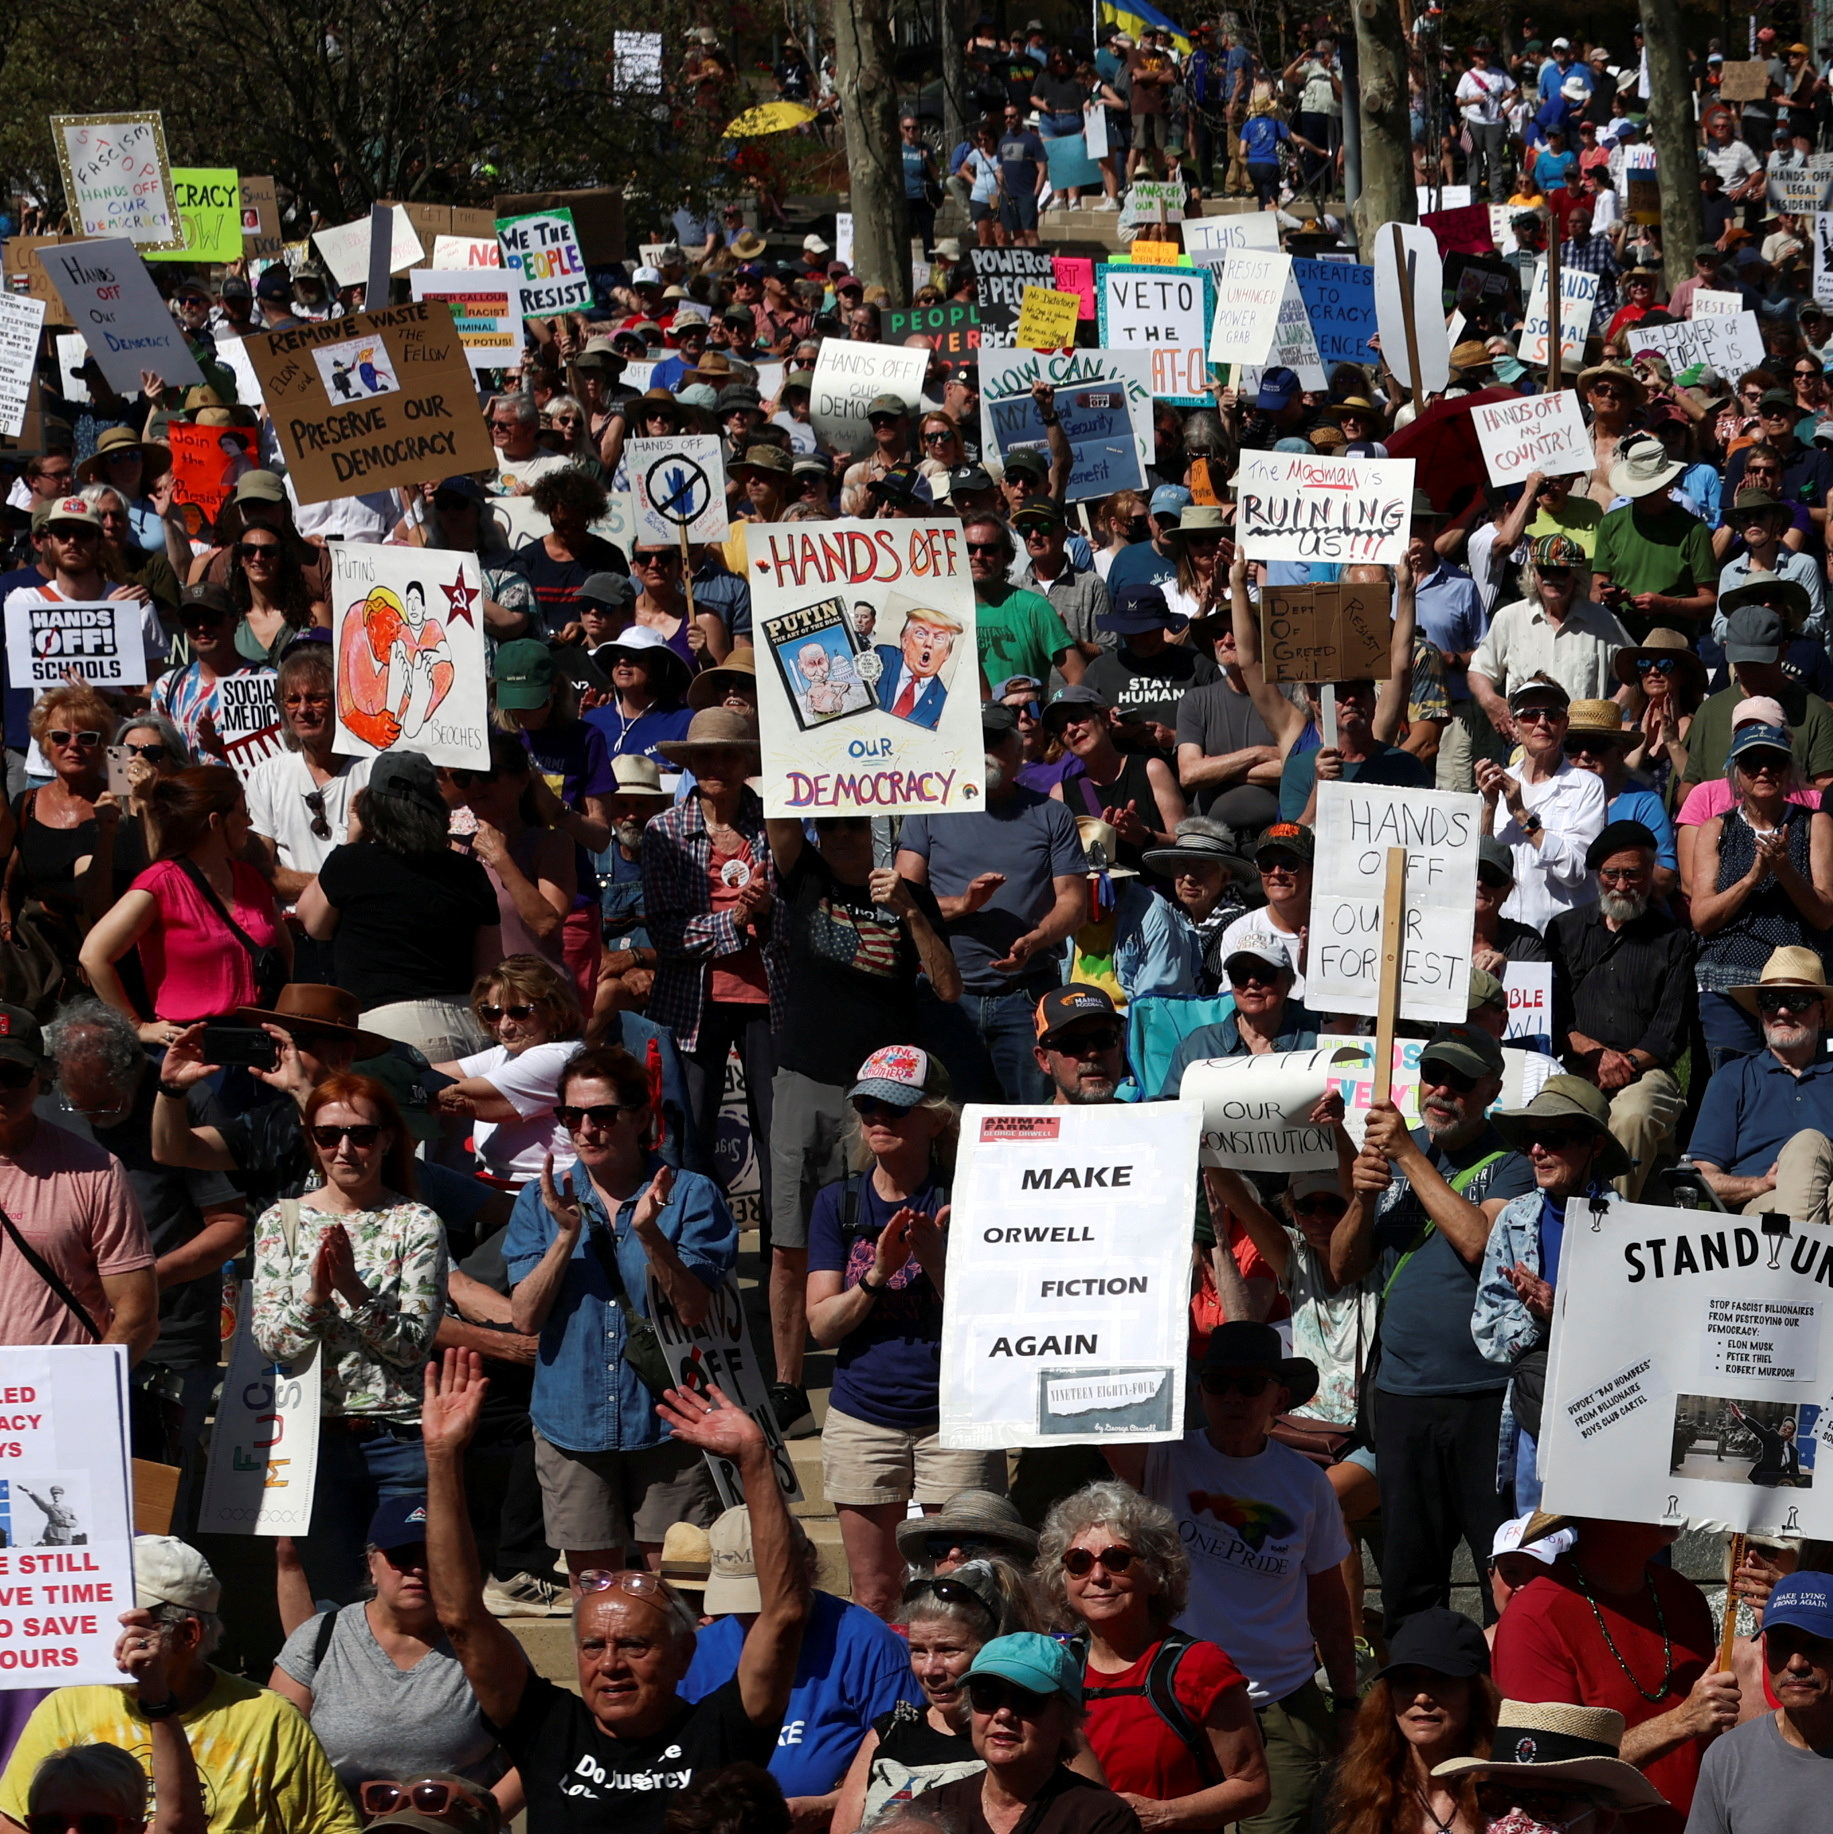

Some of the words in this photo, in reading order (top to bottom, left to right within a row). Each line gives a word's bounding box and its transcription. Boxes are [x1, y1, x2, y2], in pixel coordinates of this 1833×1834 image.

[1771, 171, 1806, 181] HANDS
[1813, 171, 1830, 181] OFF
[1786, 185, 1817, 194] LEGAL
[498, 229, 529, 250] WE
[534, 223, 570, 246] THE
[507, 245, 585, 281] PEOPLE
[1227, 259, 1271, 279] RESIST
[520, 282, 586, 312] RESIST
[1112, 282, 1192, 311] VETO
[1227, 288, 1276, 304] UNHINGED
[468, 308, 506, 317] RACIST
[1219, 311, 1256, 326] POWER
[267, 321, 359, 355] REMOVE
[367, 303, 428, 328] WASTE
[1123, 326, 1178, 341] THE
[1226, 331, 1250, 343] GRAB
[473, 338, 512, 347] POTUS!
[1484, 403, 1531, 431] HANDS
[1536, 394, 1562, 418] OFF
[290, 408, 386, 459] PRESERVE
[404, 395, 451, 420] OUR
[333, 432, 456, 482] DEMOCRACY
[1494, 427, 1572, 471] COUNTRY
[1248, 460, 1279, 481] The
[1288, 459, 1358, 488] Madman
[772, 531, 902, 586] HANDS
[909, 529, 957, 577] OFF
[32, 611, 111, 628] HANDS
[766, 600, 839, 638] PUTIN
[36, 628, 116, 656] OFF!
[33, 661, 121, 679] SCHOOLS
[849, 738, 893, 758] OUR
[785, 769, 956, 806] DEMOCRACY
[1351, 800, 1469, 847] HANDS
[1358, 850, 1444, 884] OFF
[1334, 903, 1421, 938] OUR
[1321, 945, 1464, 989] FOREST
[1022, 1166, 1133, 1189] MAKE
[984, 1227, 1094, 1243] ORWELL
[1625, 1234, 1759, 1281] STAND
[1041, 1277, 1147, 1297] FICTION
[989, 1335, 1097, 1357] AGAIN
[1726, 1351, 1749, 1362] PETER
[1752, 1354, 1772, 1363] THIEL
[1728, 1340, 1747, 1349] ELON
[1750, 1341, 1773, 1351] MUSK
[1726, 1364, 1755, 1376] ROBERT
[1758, 1366, 1794, 1377] MURDOCH
